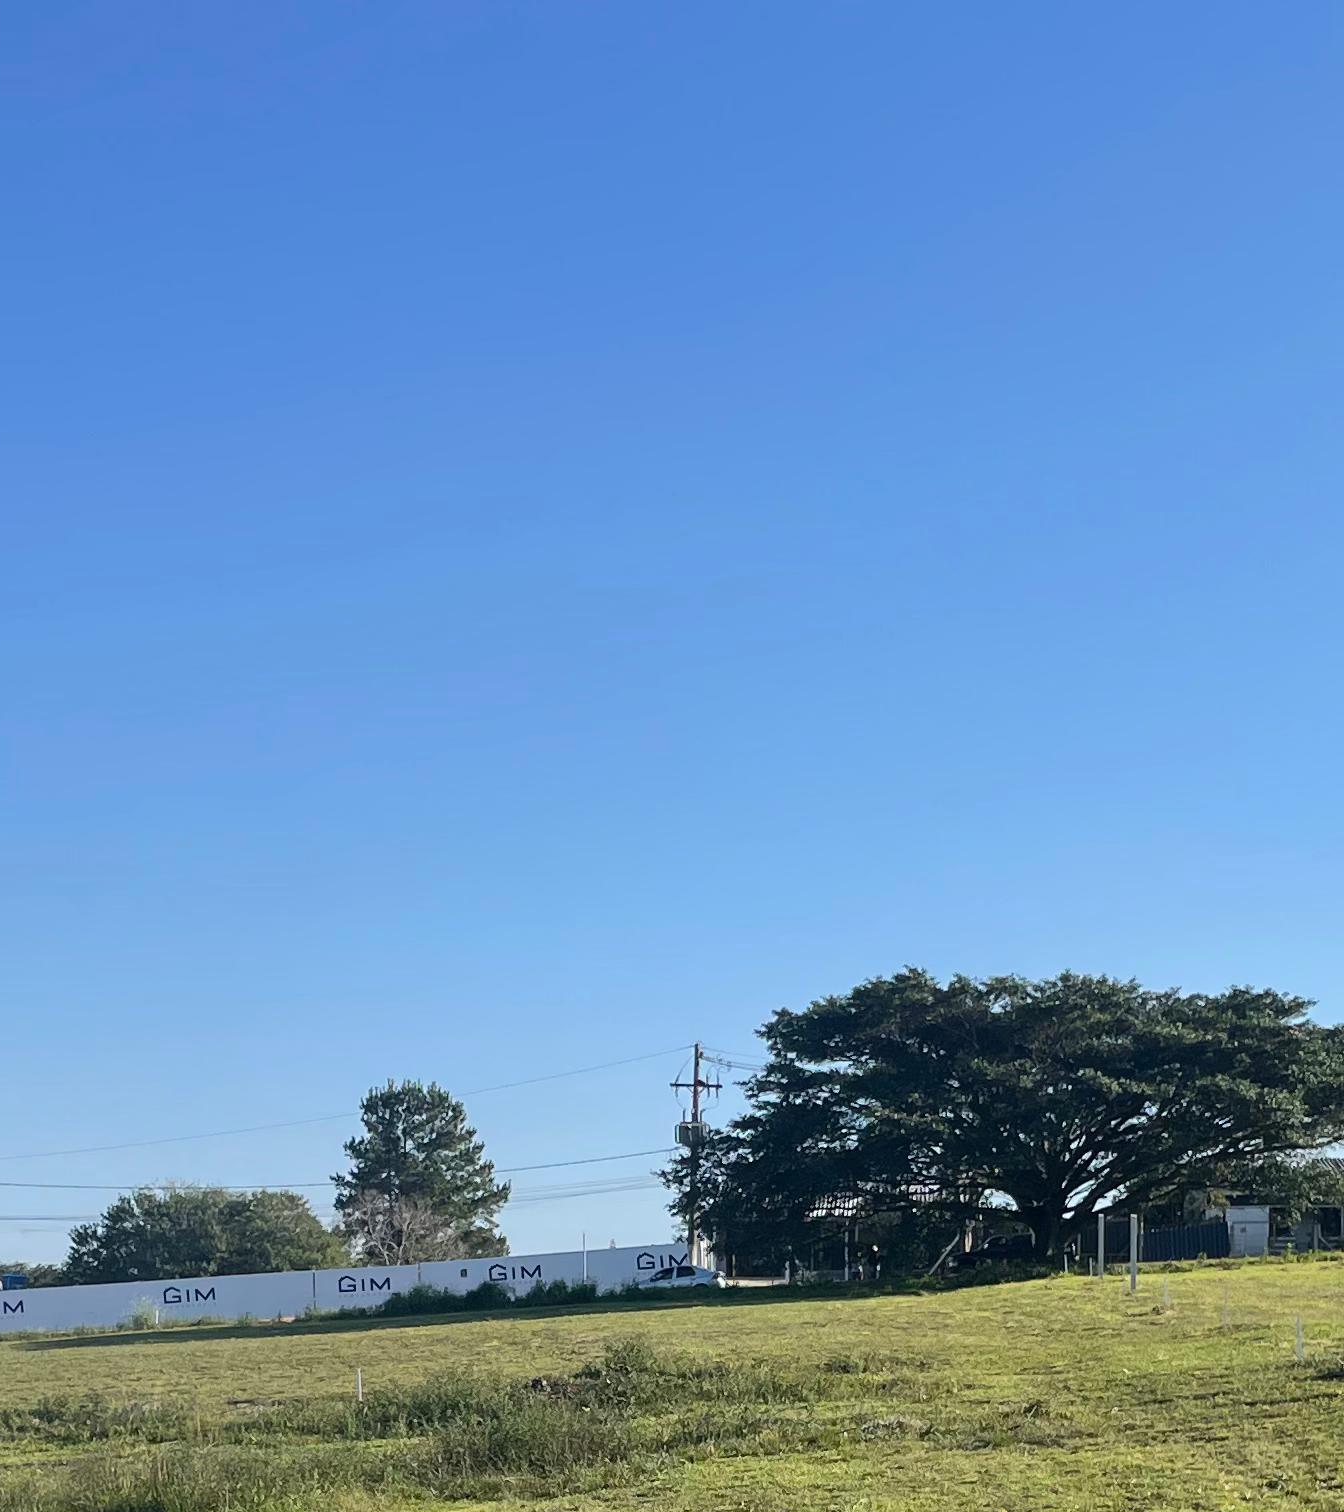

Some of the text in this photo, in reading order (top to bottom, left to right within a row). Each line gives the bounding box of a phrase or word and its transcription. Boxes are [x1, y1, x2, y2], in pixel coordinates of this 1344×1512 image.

[488, 1263, 542, 1281] GIM
[338, 1275, 391, 1292] GIM
[163, 1286, 216, 1304] GIM
